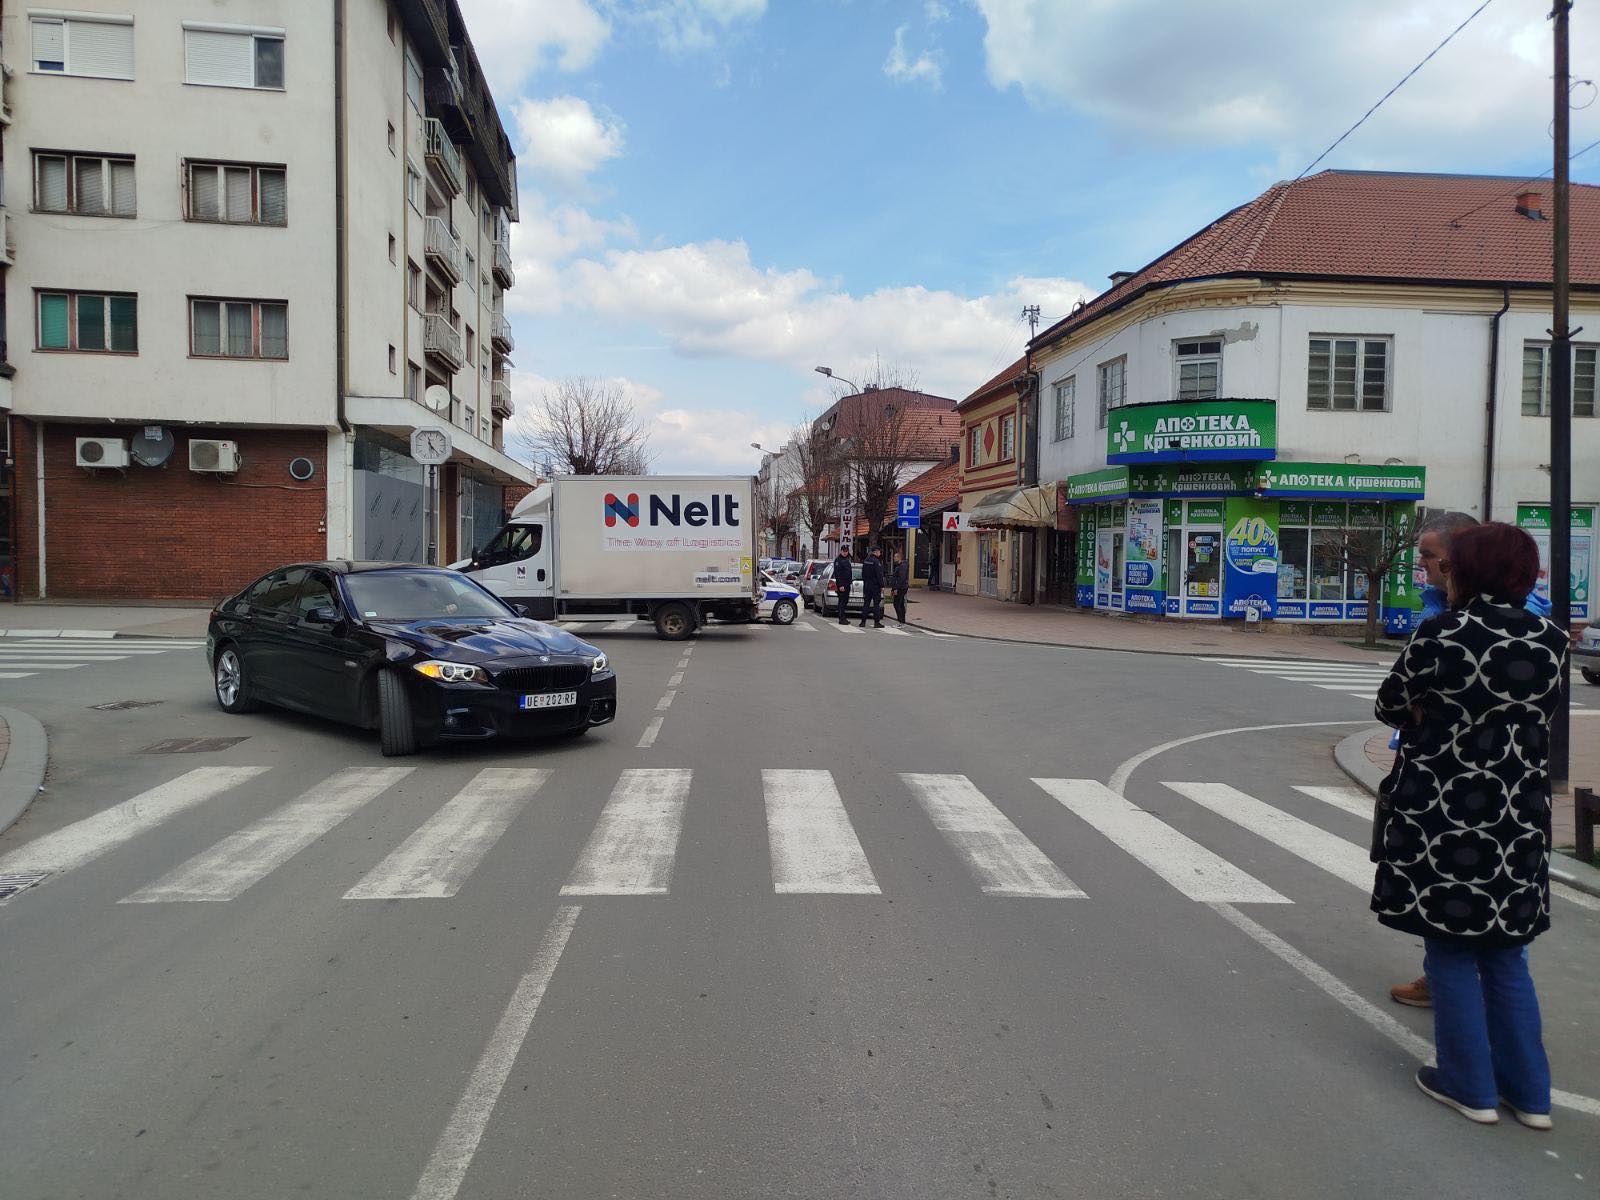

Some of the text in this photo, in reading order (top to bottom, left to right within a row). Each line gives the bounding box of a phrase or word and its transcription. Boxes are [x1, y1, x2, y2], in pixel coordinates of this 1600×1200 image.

[1154, 414, 1250, 433] АПОТЕКА
[1178, 472, 1231, 483] АПОТЕКА
[1279, 474, 1422, 490] АПОТЕКА Кршенковић
[1171, 479, 1237, 493] Кршенковић
[649, 494, 740, 527] Nelt
[902, 497, 916, 515] P
[945, 514, 960, 530] A1
[1231, 516, 1276, 547] 40%
[608, 536, 741, 549] The Way of Logistics
[1086, 513, 1095, 577] АПОТЕКА
[695, 575, 741, 584] nelt.com
[527, 695, 539, 707] UE
